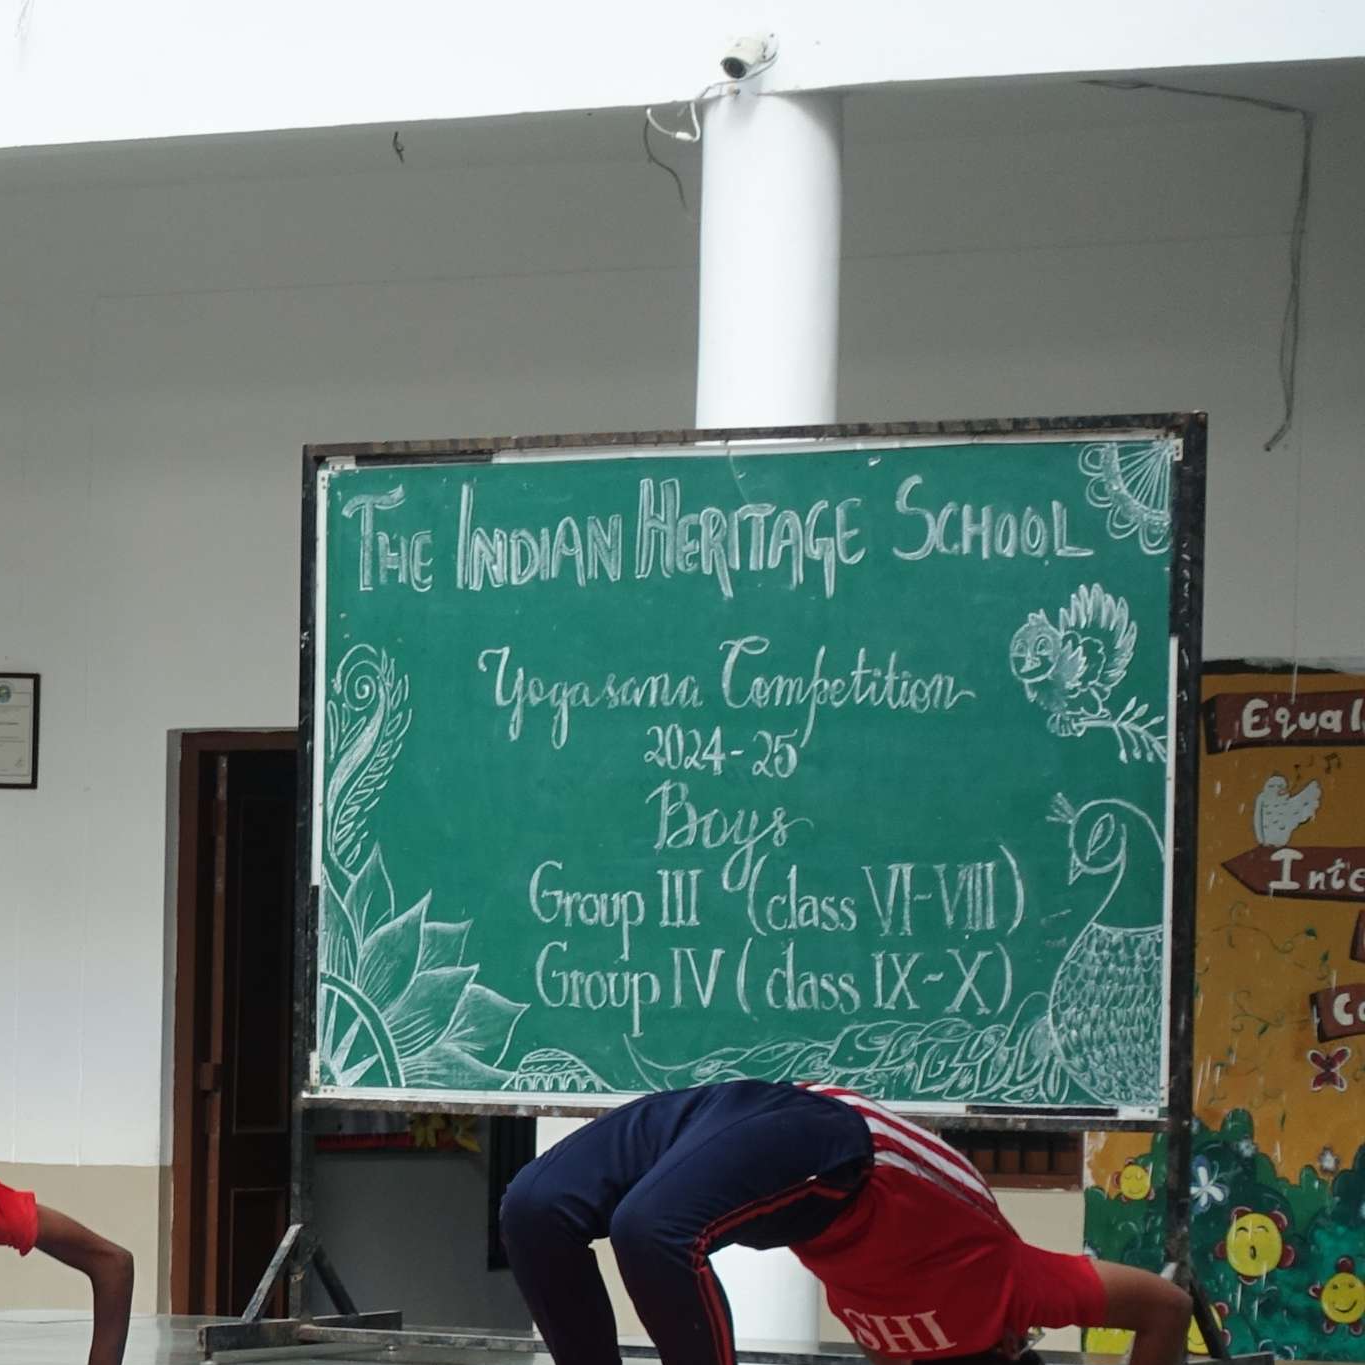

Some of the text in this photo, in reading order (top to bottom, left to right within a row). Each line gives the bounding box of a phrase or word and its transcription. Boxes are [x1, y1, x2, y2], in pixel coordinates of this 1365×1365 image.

[456, 479, 623, 592] INDIAN
[635, 477, 867, 599] HERITAGE
[892, 474, 1094, 560] SCHOOL
[719, 635, 977, 748] Competition
[1242, 698, 1365, 739] Equal
[645, 779, 815, 893] Boys
[529, 860, 645, 963] Group
[656, 868, 704, 928] III
[747, 854, 858, 936] (class
[535, 941, 661, 1038] Group
[669, 947, 726, 1009] IV
